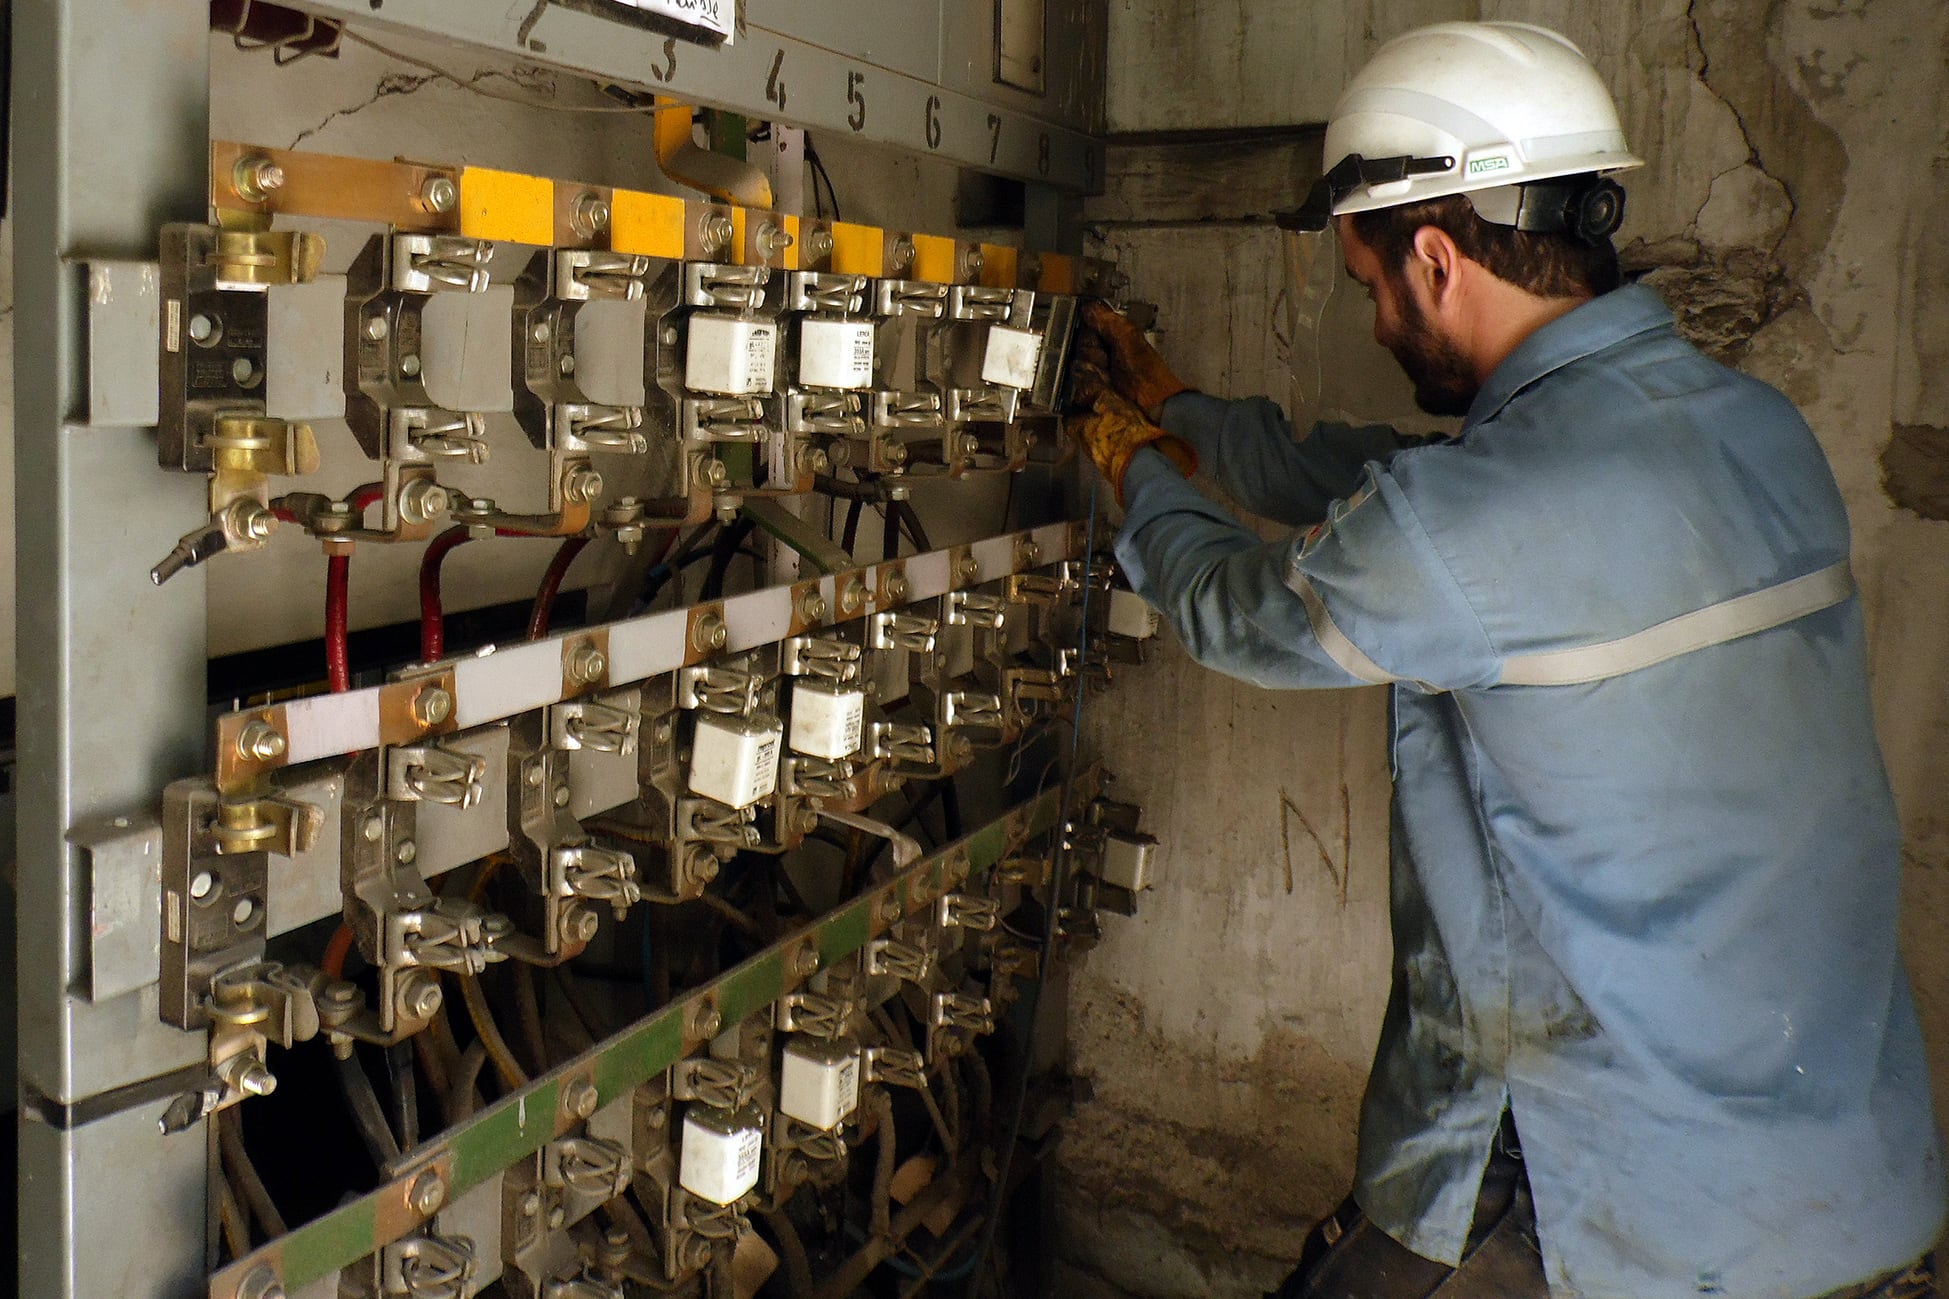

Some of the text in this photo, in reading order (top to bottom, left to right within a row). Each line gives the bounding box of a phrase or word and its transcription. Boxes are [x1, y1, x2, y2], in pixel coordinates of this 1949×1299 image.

[766, 49, 787, 113] 4
[848, 70, 866, 132] 5
[926, 95, 942, 150] 6
[986, 113, 1002, 164] 7
[1470, 157, 1509, 173] MSA
